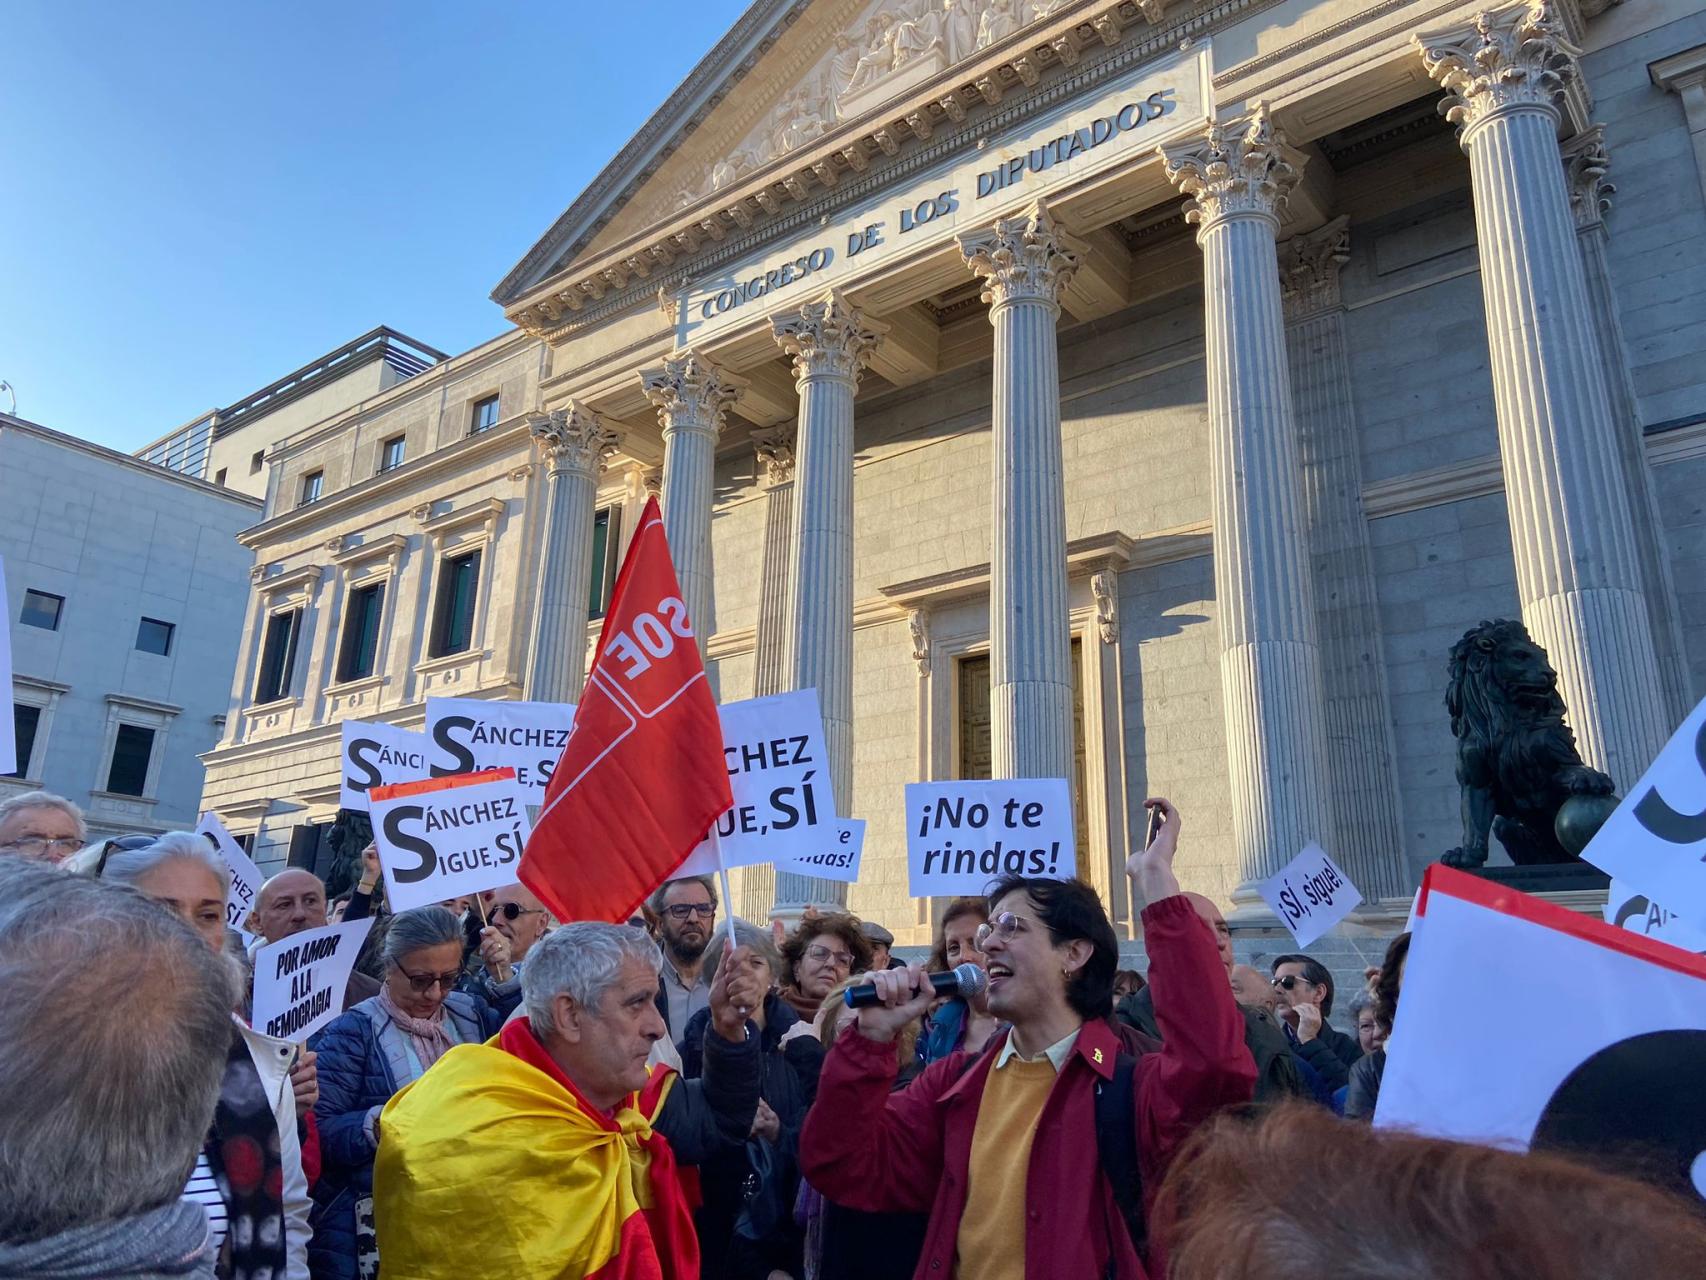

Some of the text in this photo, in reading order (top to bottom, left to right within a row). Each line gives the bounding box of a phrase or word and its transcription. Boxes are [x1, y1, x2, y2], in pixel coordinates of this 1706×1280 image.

[702, 90, 1166, 320] CONGRESO DE LOS DIPUTADOS
[430, 716, 569, 777] SÁNCHEZ
[724, 735, 813, 775] CHEZ
[703, 770, 817, 841] UE,SÍ
[919, 797, 1044, 838] ¡No te
[383, 797, 518, 883] SÁNCHEZ
[838, 830, 851, 844] e
[923, 841, 1060, 875] rindas!
[1302, 858, 1343, 906] sigue!
[276, 934, 341, 980] POR AMOR
[291, 968, 312, 1003] A LA
[267, 986, 332, 1038] DEMOCRACIA
